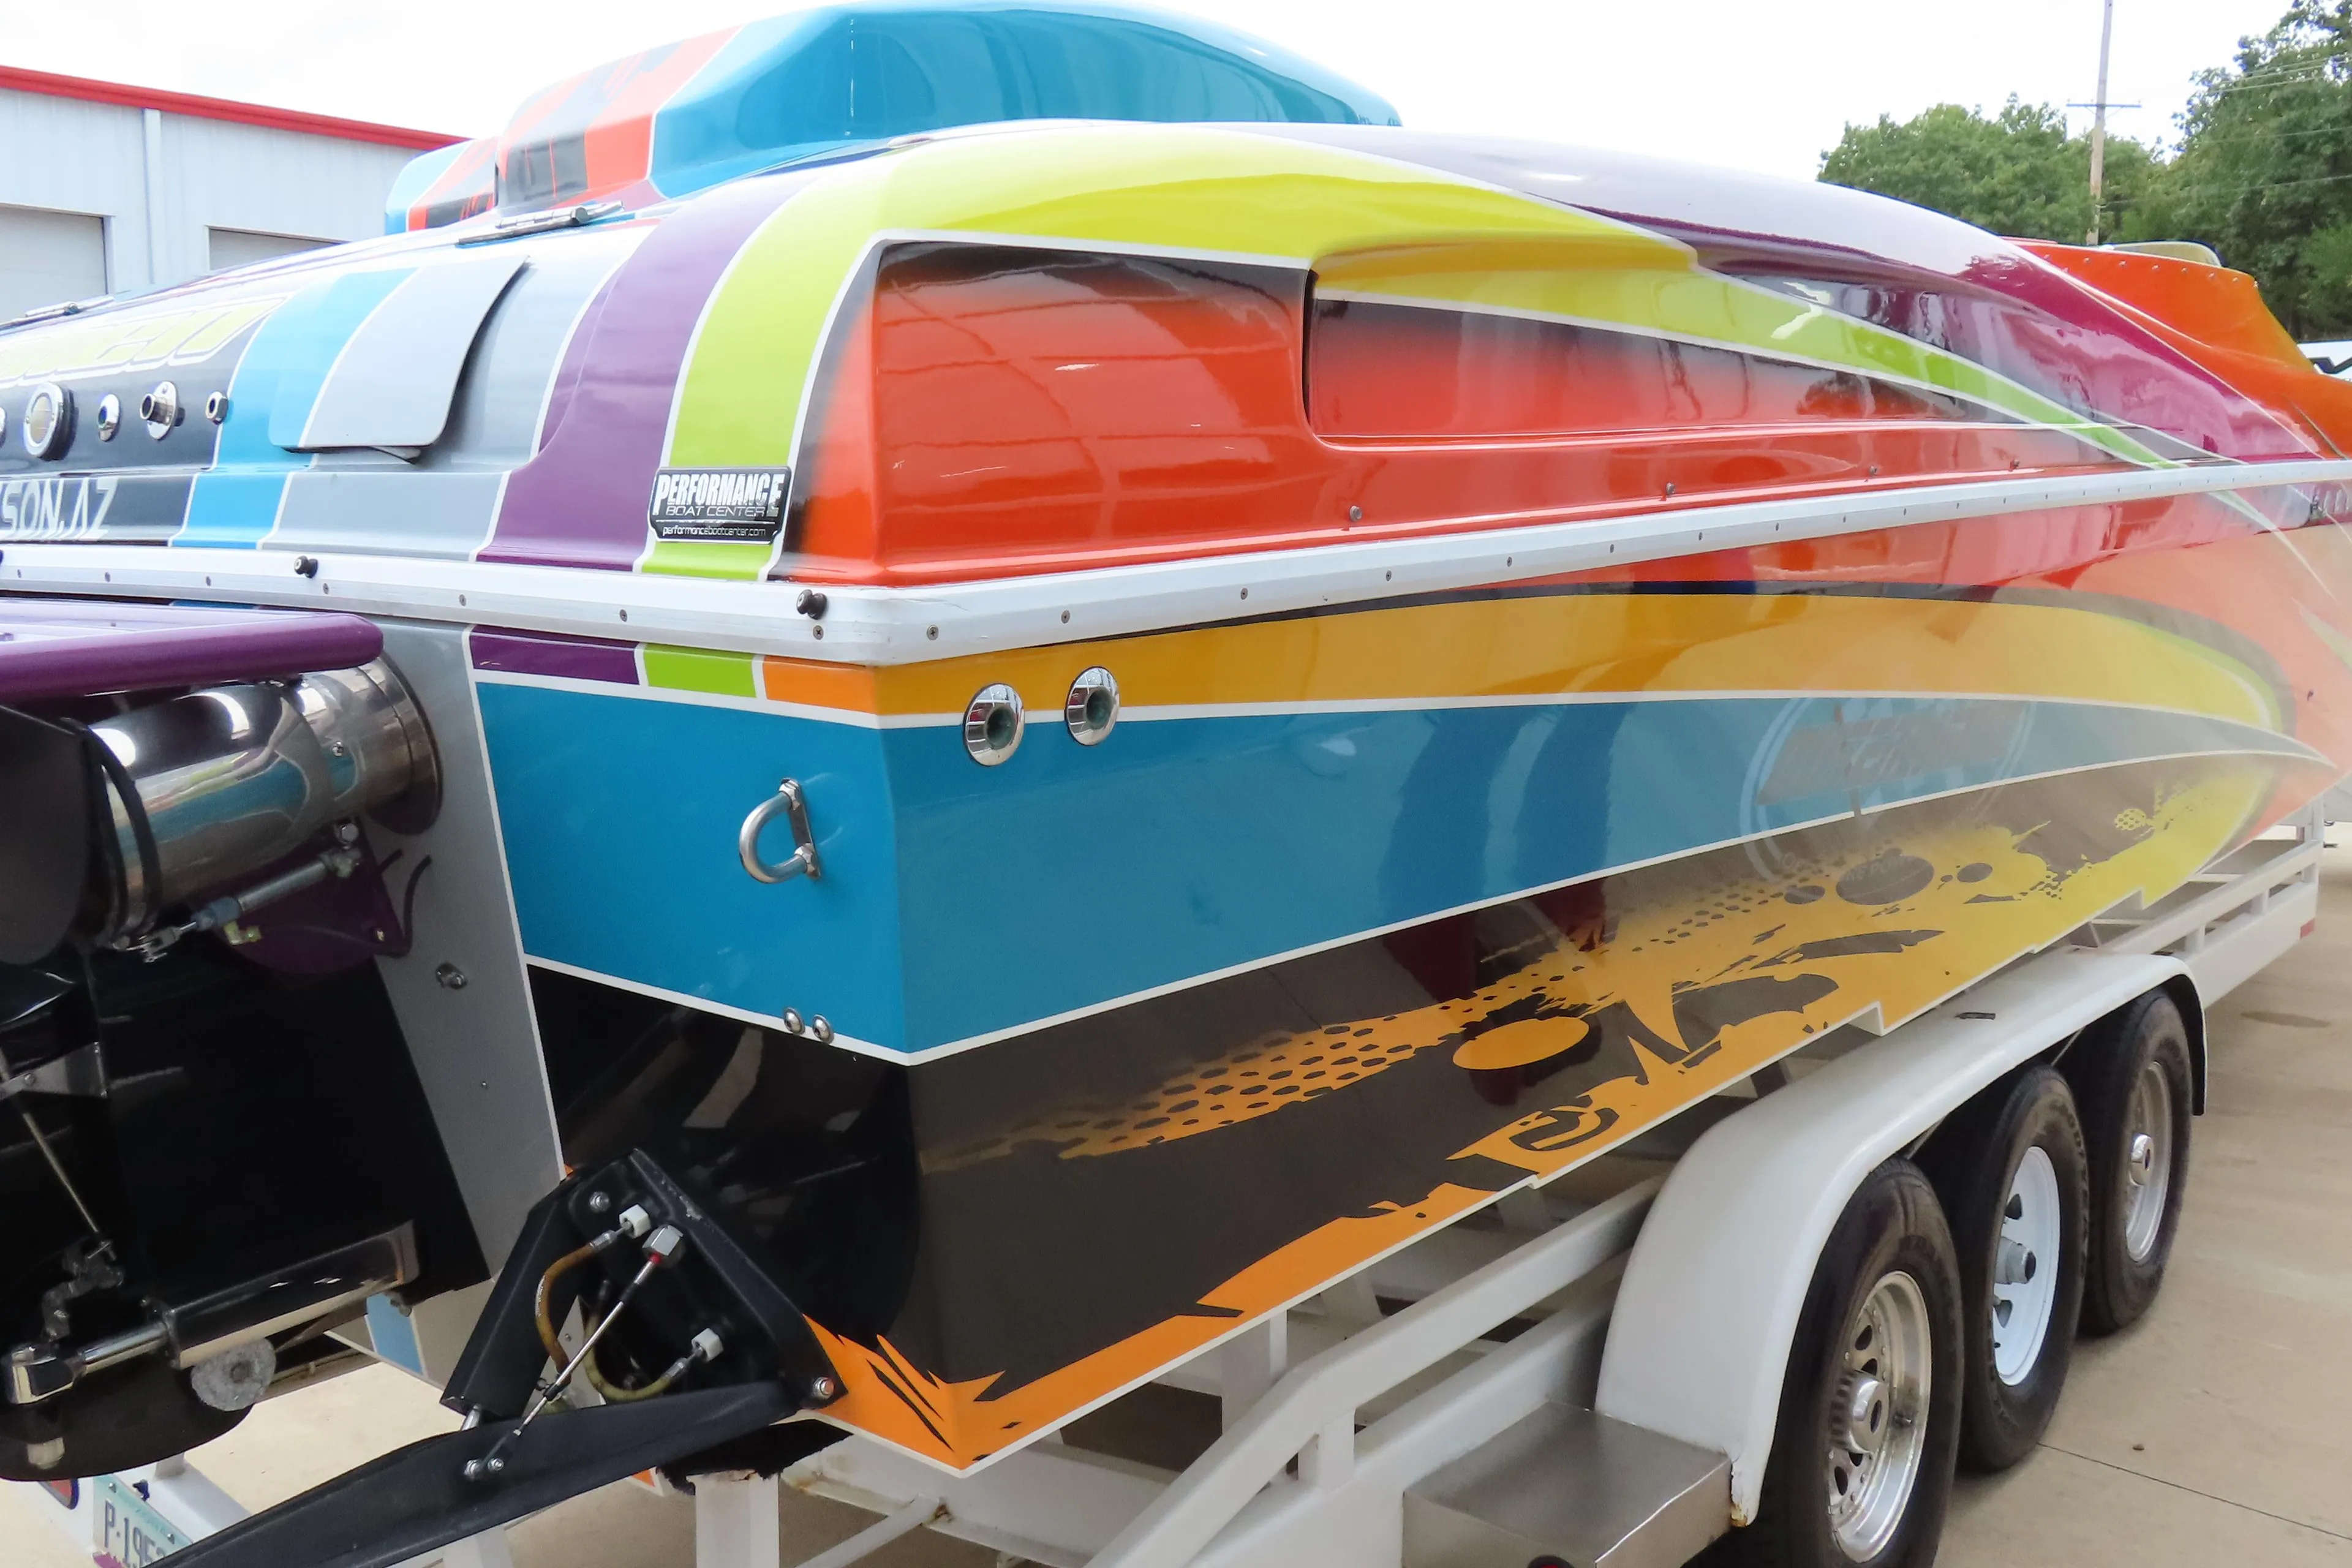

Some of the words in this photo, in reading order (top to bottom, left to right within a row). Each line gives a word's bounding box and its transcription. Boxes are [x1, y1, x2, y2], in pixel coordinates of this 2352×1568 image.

[652, 473, 785, 517] PERFORMANCE
[666, 505, 705, 516] BOAT
[706, 506, 766, 517] CENTER
[662, 525, 766, 537] performanceboatcenter.com
